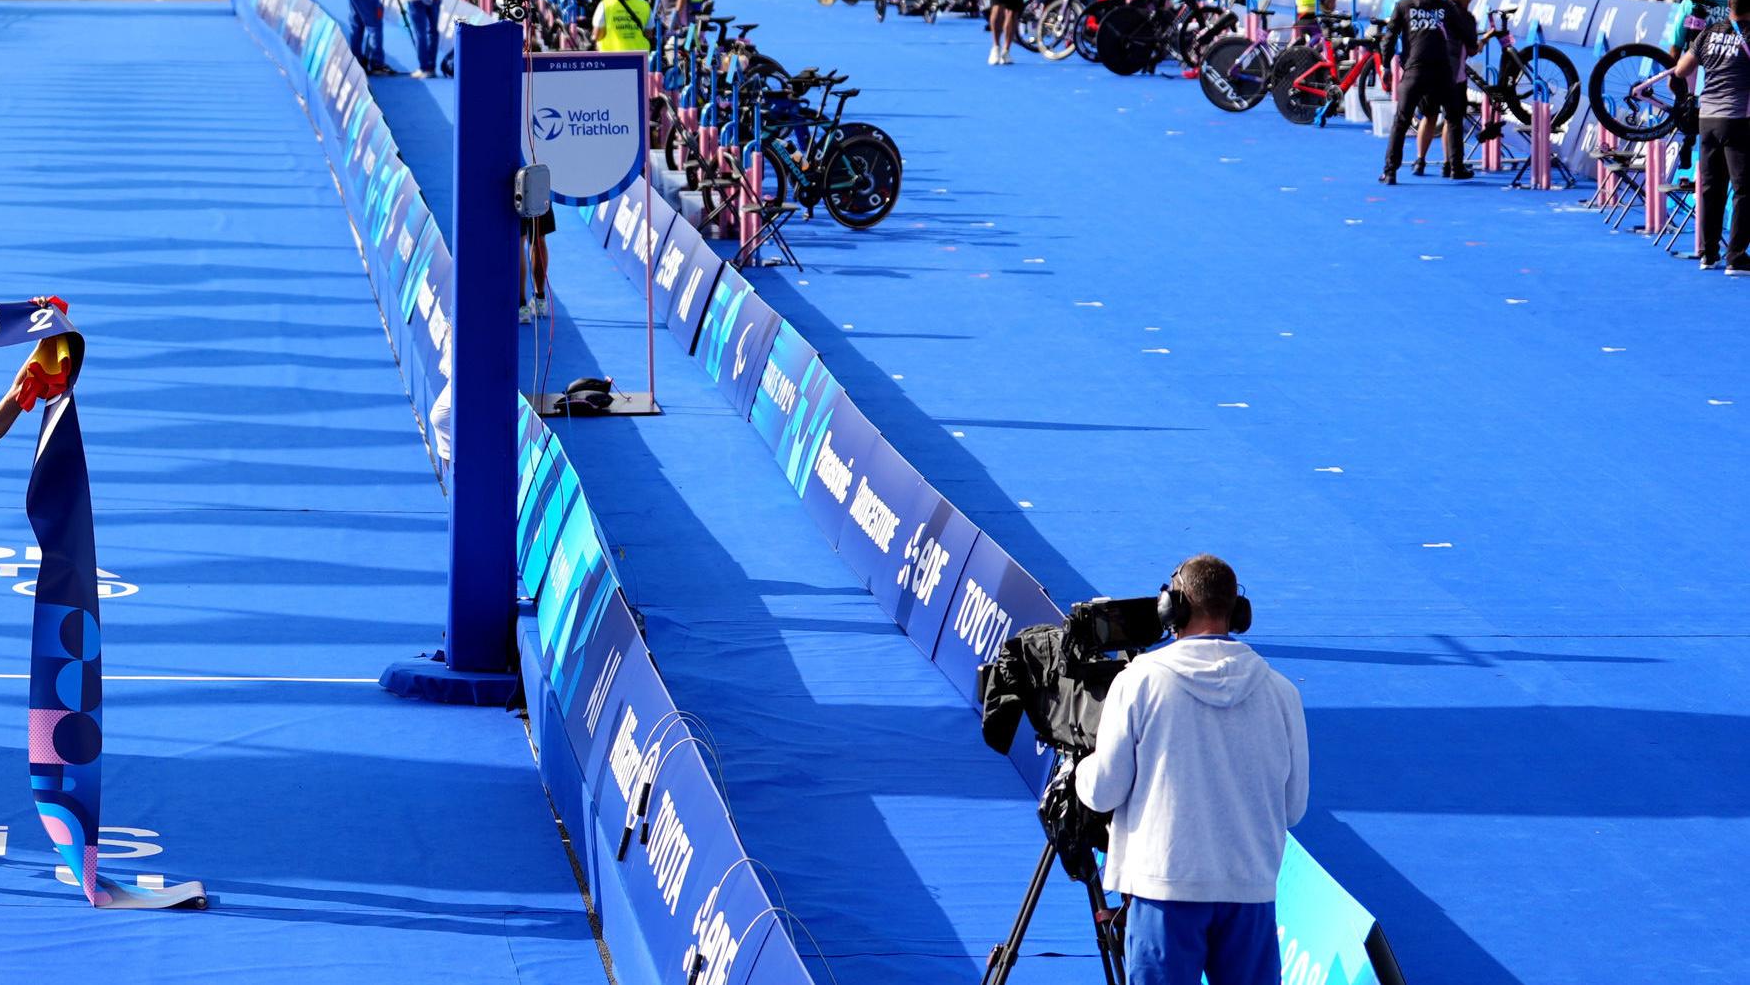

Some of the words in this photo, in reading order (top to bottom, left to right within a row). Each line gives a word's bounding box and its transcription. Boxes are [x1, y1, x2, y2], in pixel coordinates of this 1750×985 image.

[580, 61, 606, 69] 2024
[567, 109, 610, 122] World
[567, 123, 630, 136] Triathlon
[814, 430, 854, 504] Panasonic
[610, 704, 643, 803] Allianz
[646, 789, 694, 917] TOYOTA
